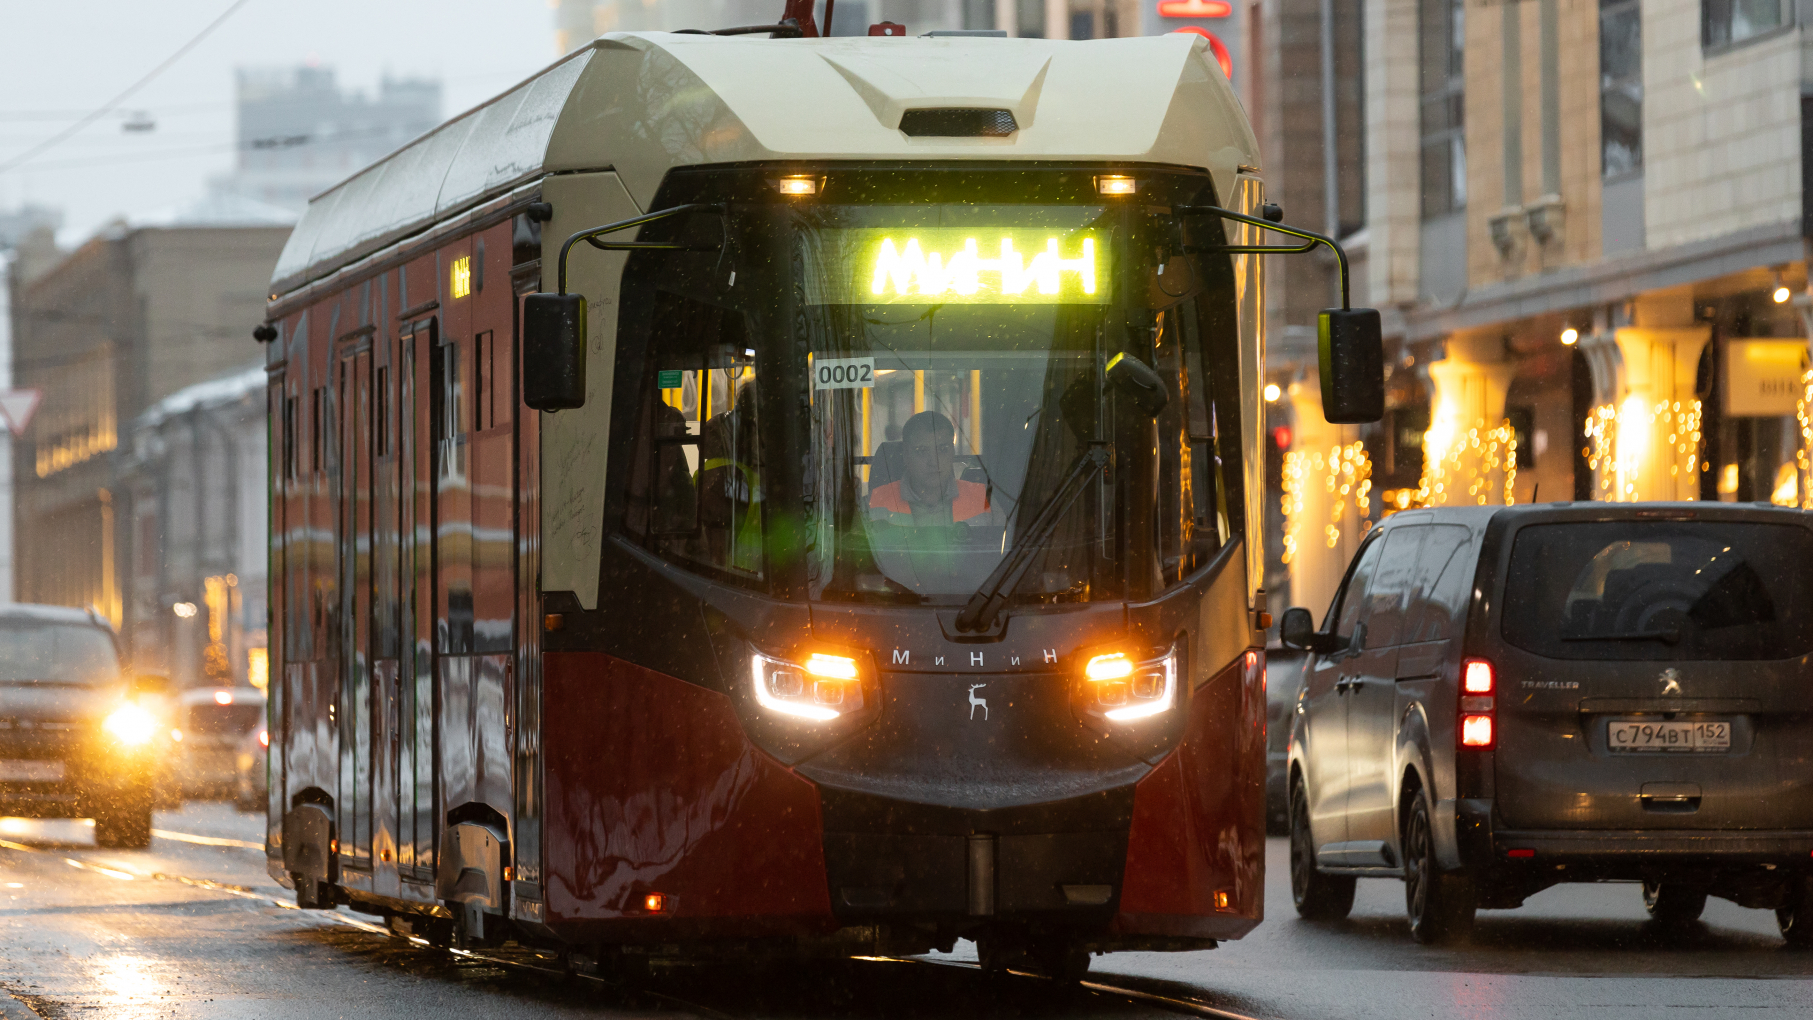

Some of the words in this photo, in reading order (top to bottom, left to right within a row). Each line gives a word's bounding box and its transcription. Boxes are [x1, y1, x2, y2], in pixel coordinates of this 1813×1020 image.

[819, 363, 872, 384] 0002
[1521, 681, 1580, 689] TRAVELLER
[1696, 724, 1726, 739] 152
